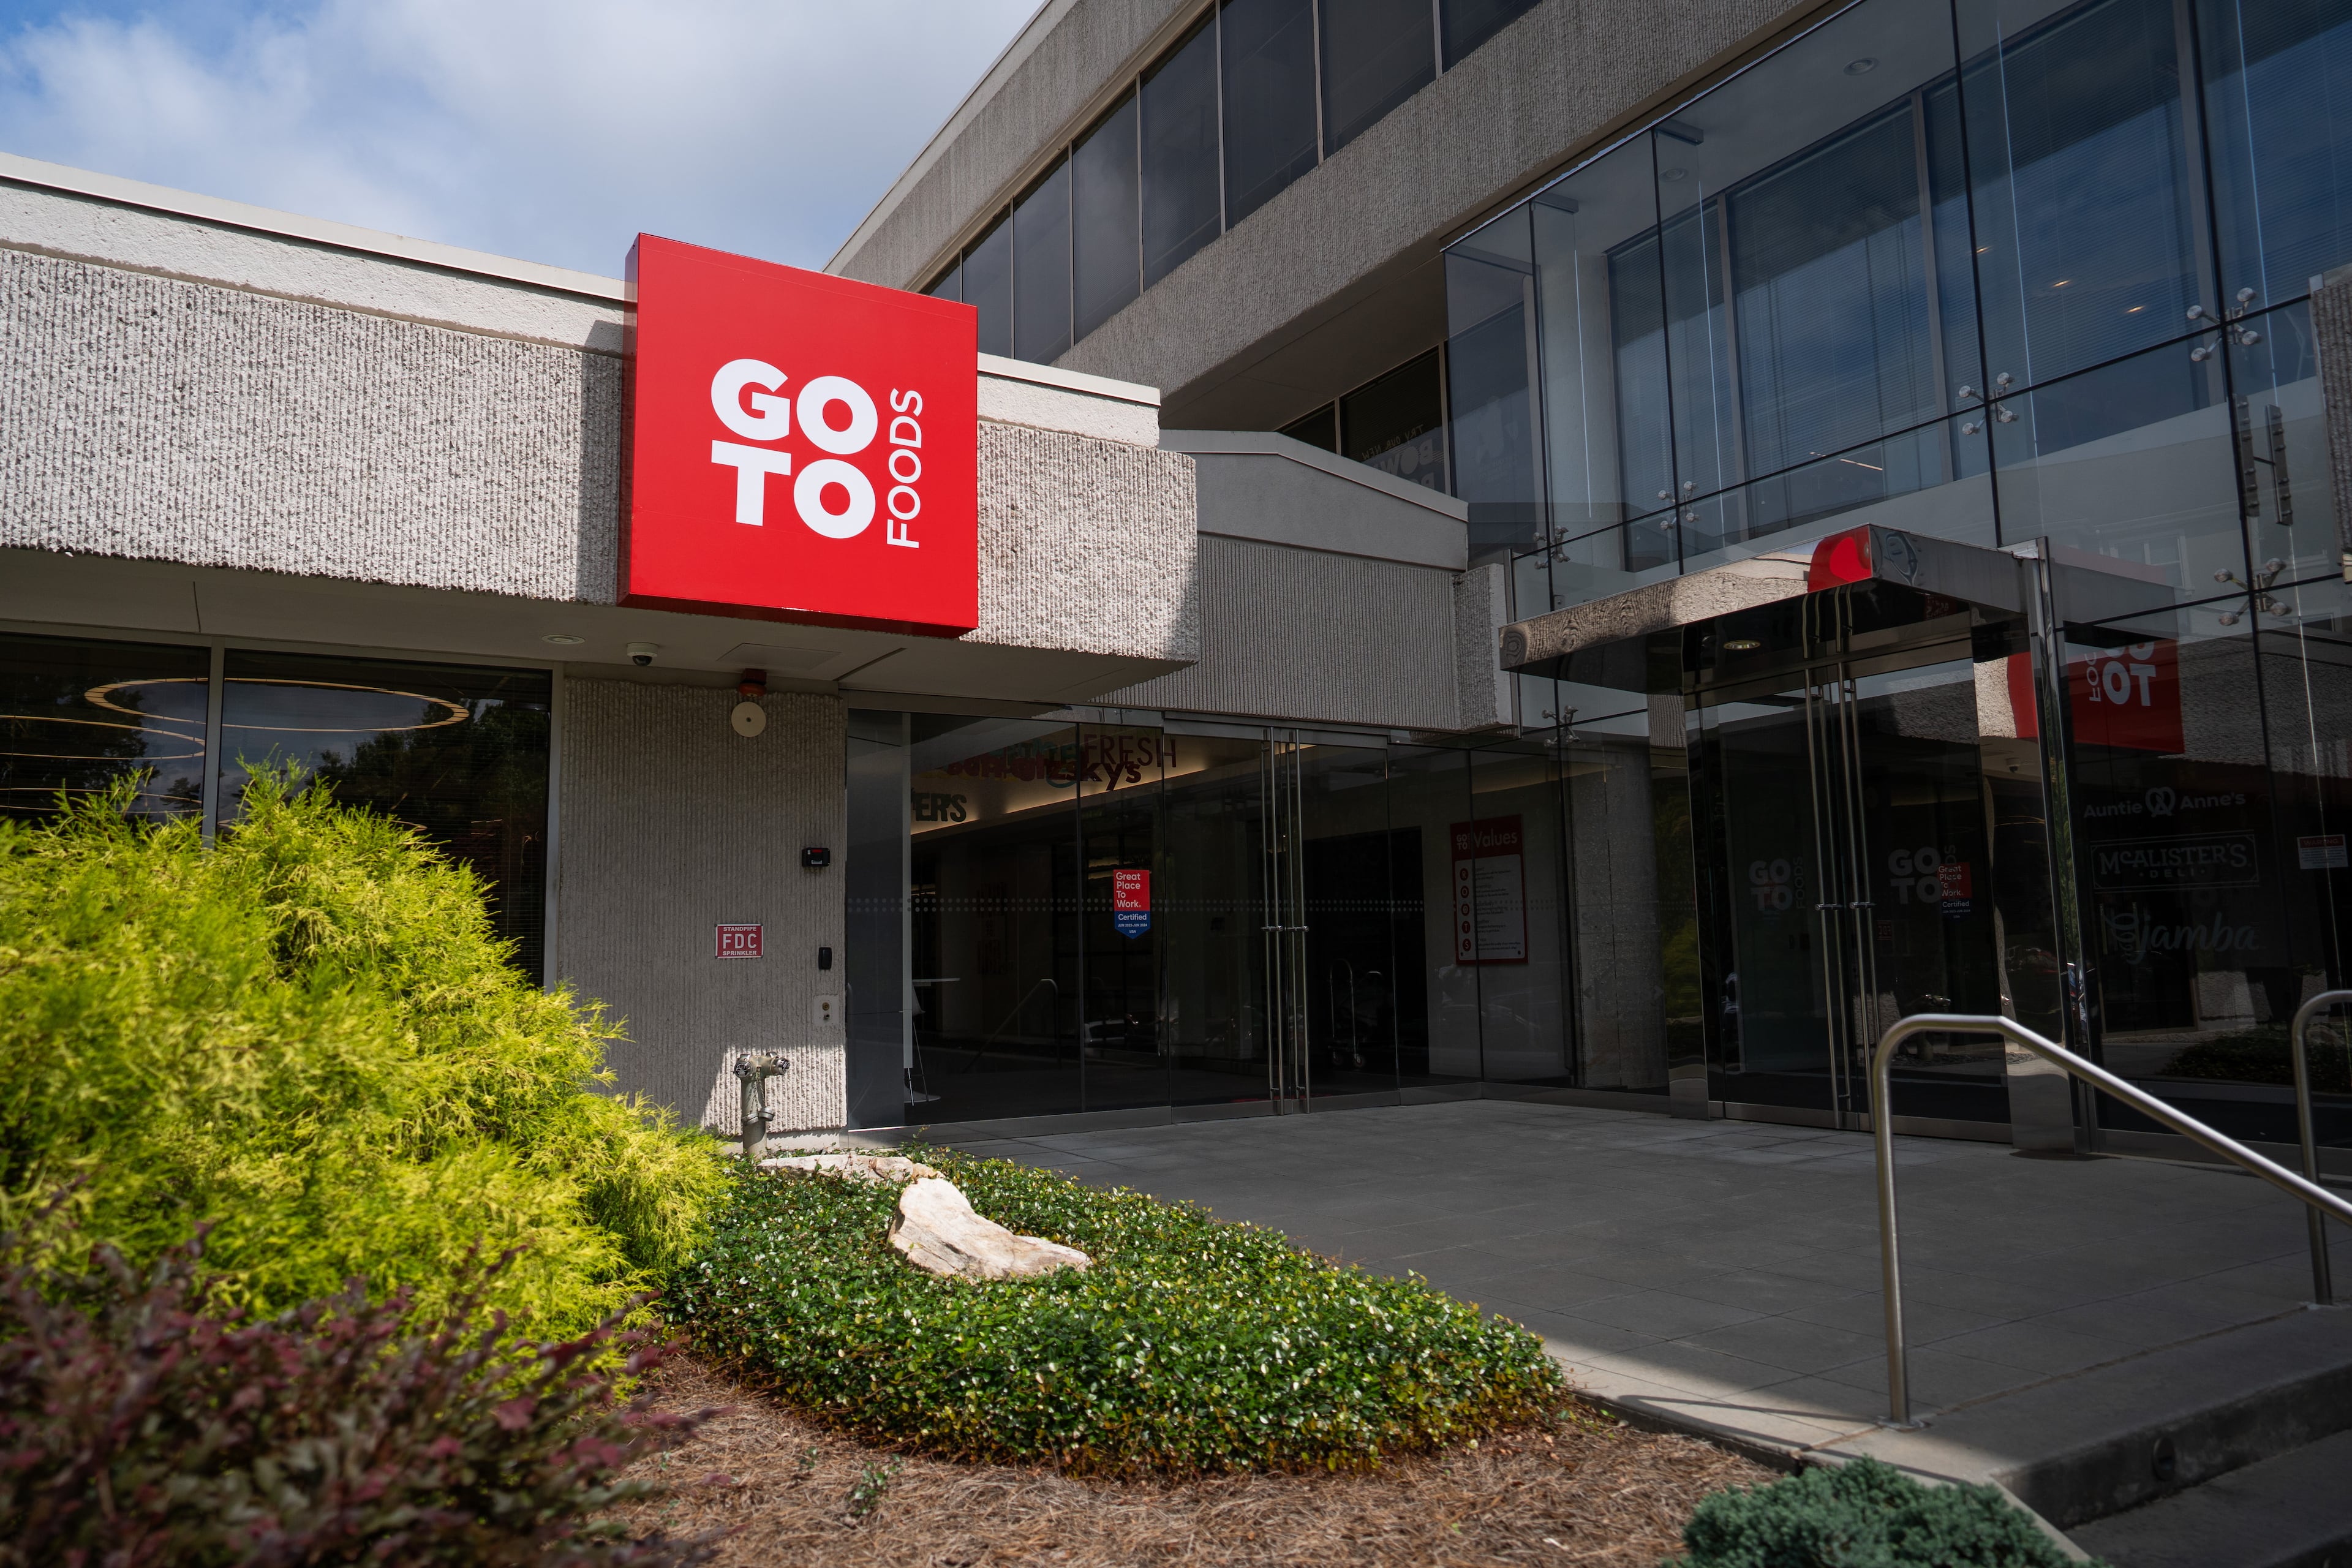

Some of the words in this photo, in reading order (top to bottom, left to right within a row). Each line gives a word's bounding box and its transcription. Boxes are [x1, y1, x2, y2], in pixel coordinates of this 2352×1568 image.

[710, 358, 878, 455] GO
[886, 388, 924, 549] FOODS
[710, 439, 876, 540] TO
[1083, 734, 1177, 768] FRESH
[2084, 801, 2143, 819] Auntie
[2180, 791, 2246, 810] Anne's
[1473, 827, 1518, 848] Values
[1749, 858, 1792, 886] GO
[1888, 846, 1942, 876] GO
[2149, 867, 2195, 879] DELI
[1116, 872, 1141, 881] Great
[1117, 881, 1141, 889] Place
[1793, 856, 1806, 910] FOODS
[1890, 875, 1942, 905] TO
[1116, 890, 1126, 899] To
[1749, 884, 1793, 911] TO
[722, 933, 757, 949] FDC
